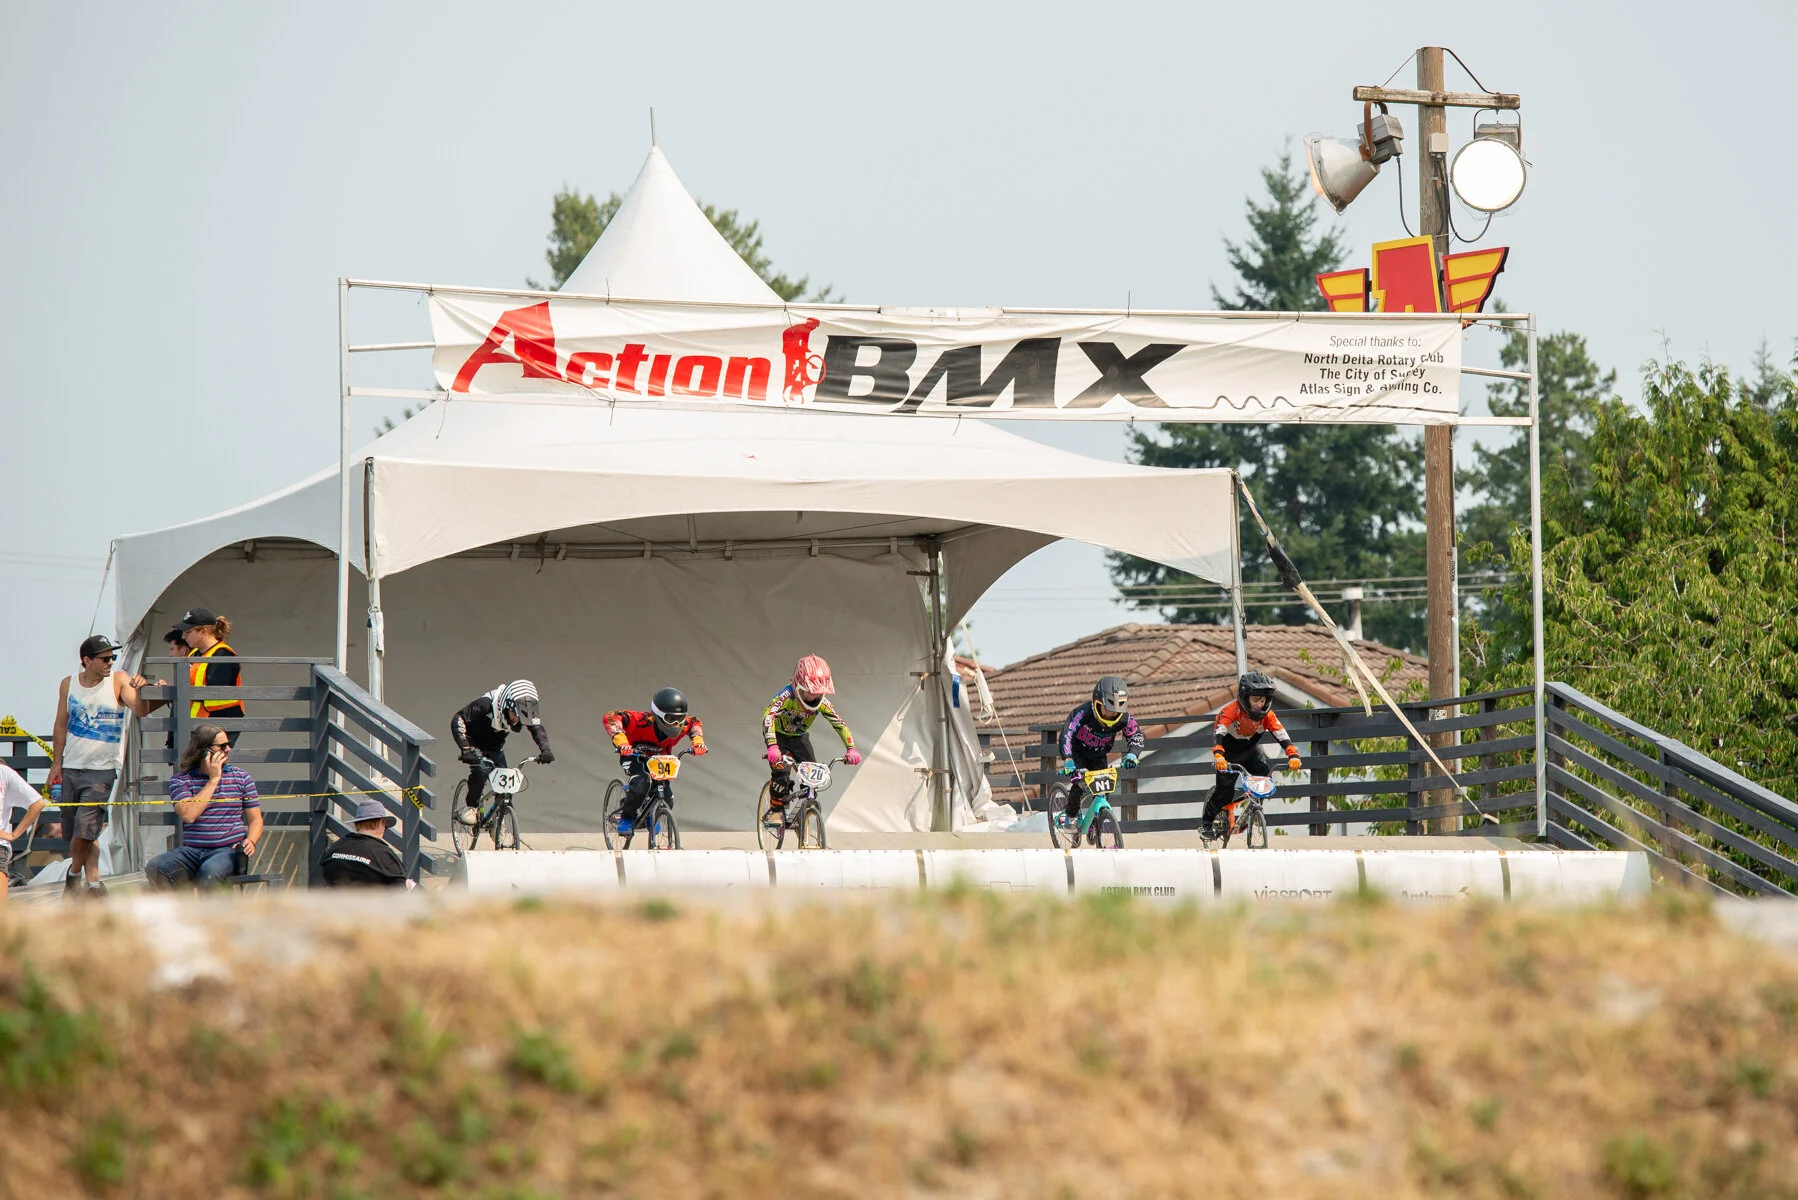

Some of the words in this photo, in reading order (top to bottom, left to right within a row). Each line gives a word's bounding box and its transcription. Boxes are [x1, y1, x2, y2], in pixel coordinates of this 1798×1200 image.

[1329, 335, 1367, 348] Special
[1370, 336, 1404, 347] thanks
[1407, 337, 1421, 347] to:
[451, 301, 772, 400] Action
[813, 334, 1190, 414] BMX
[1304, 353, 1338, 365] North
[1342, 354, 1373, 365] Delta
[1377, 354, 1416, 368] Rotary
[1320, 368, 1341, 380] The
[1345, 368, 1370, 382] City
[1373, 368, 1386, 380] of
[1300, 383, 1330, 395] Atlas
[1334, 384, 1361, 396] Sign
[1365, 384, 1375, 394] &
[1423, 381, 1443, 395] Co.
[657, 762, 671, 775] 94
[498, 774, 515, 787] 31
[1094, 779, 1111, 792] N1
[331, 852, 372, 865] COMMISSAIRE
[1133, 886, 1153, 897] BMX
[1154, 886, 1176, 897] CLUB
